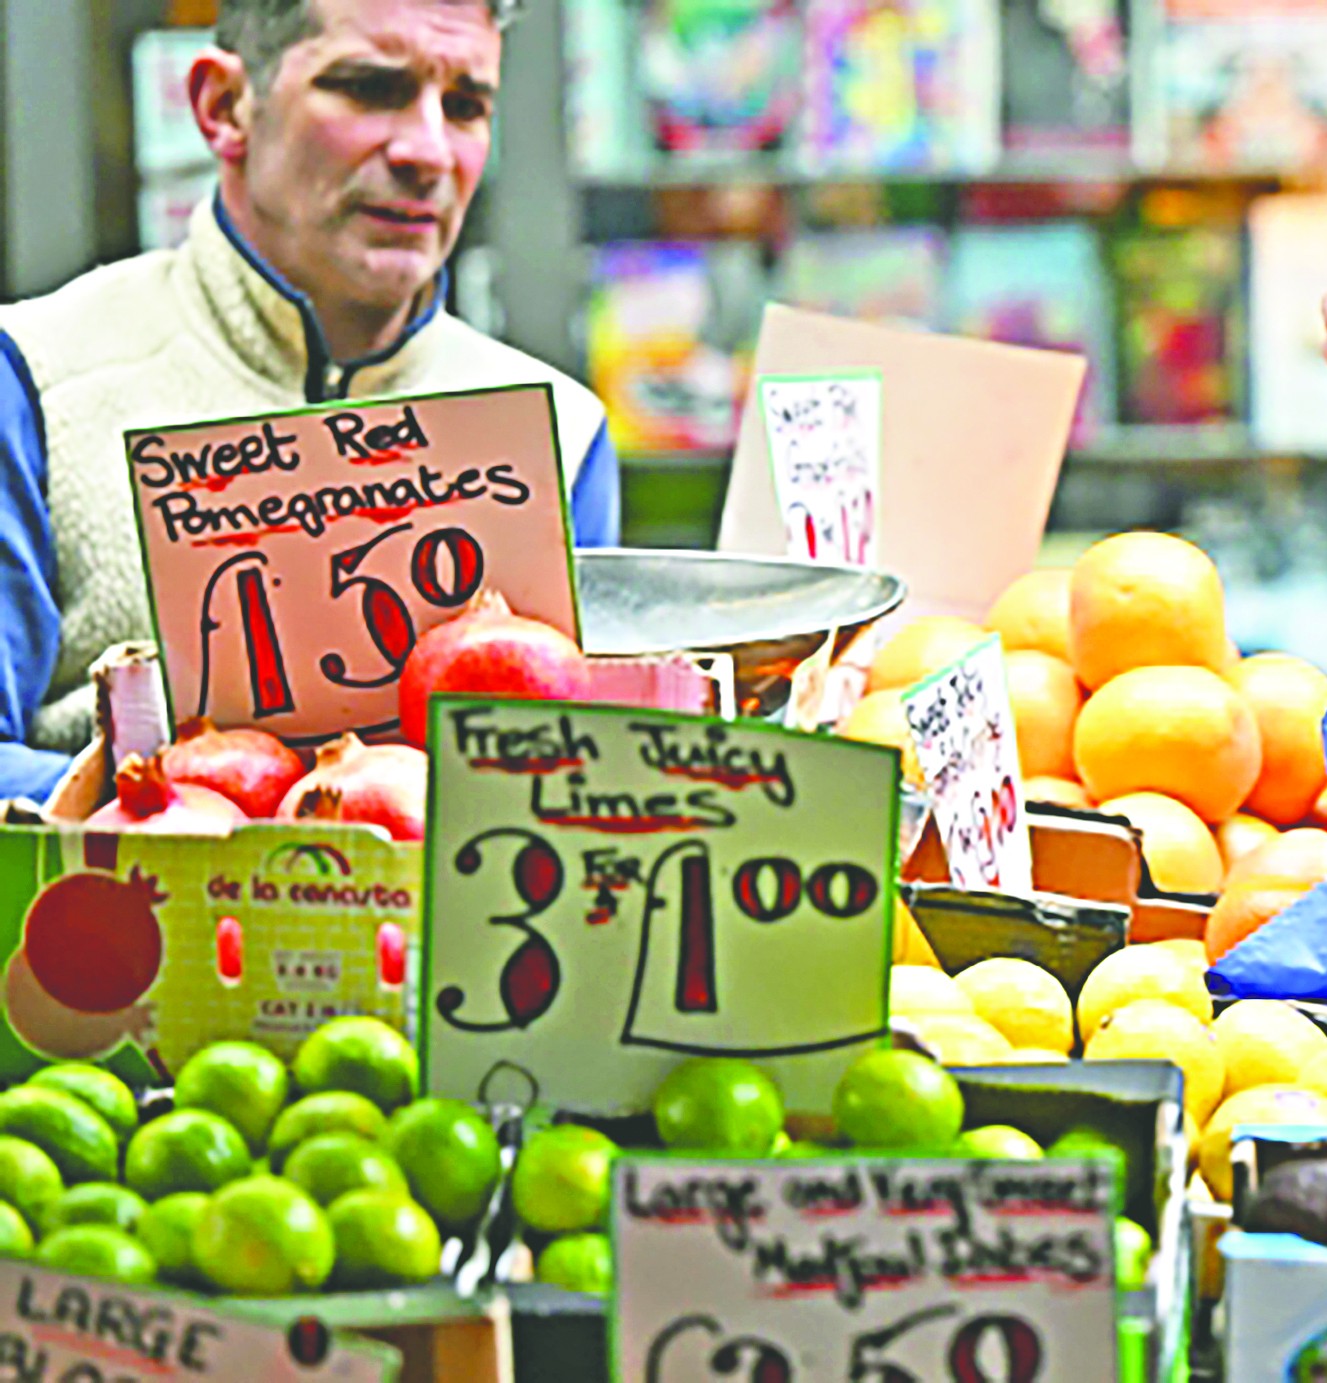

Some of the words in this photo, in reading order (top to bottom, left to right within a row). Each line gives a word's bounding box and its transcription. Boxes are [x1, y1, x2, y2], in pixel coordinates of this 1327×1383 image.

[131, 423, 299, 488] Sweet
[323, 405, 429, 459] Red
[151, 464, 530, 542] Pomegranates
[449, 708, 599, 760] Fresh
[627, 723, 795, 807] Juicy
[530, 773, 737, 827] Limes
[207, 874, 241, 900] de
[252, 875, 278, 900] la
[436, 827, 564, 1030] 3
[624, 1166, 768, 1250] Large
[782, 1168, 862, 1209] and
[868, 1166, 970, 1236] Very
[938, 1228, 1101, 1282] Dates
[16, 1276, 223, 1372] LARGE
